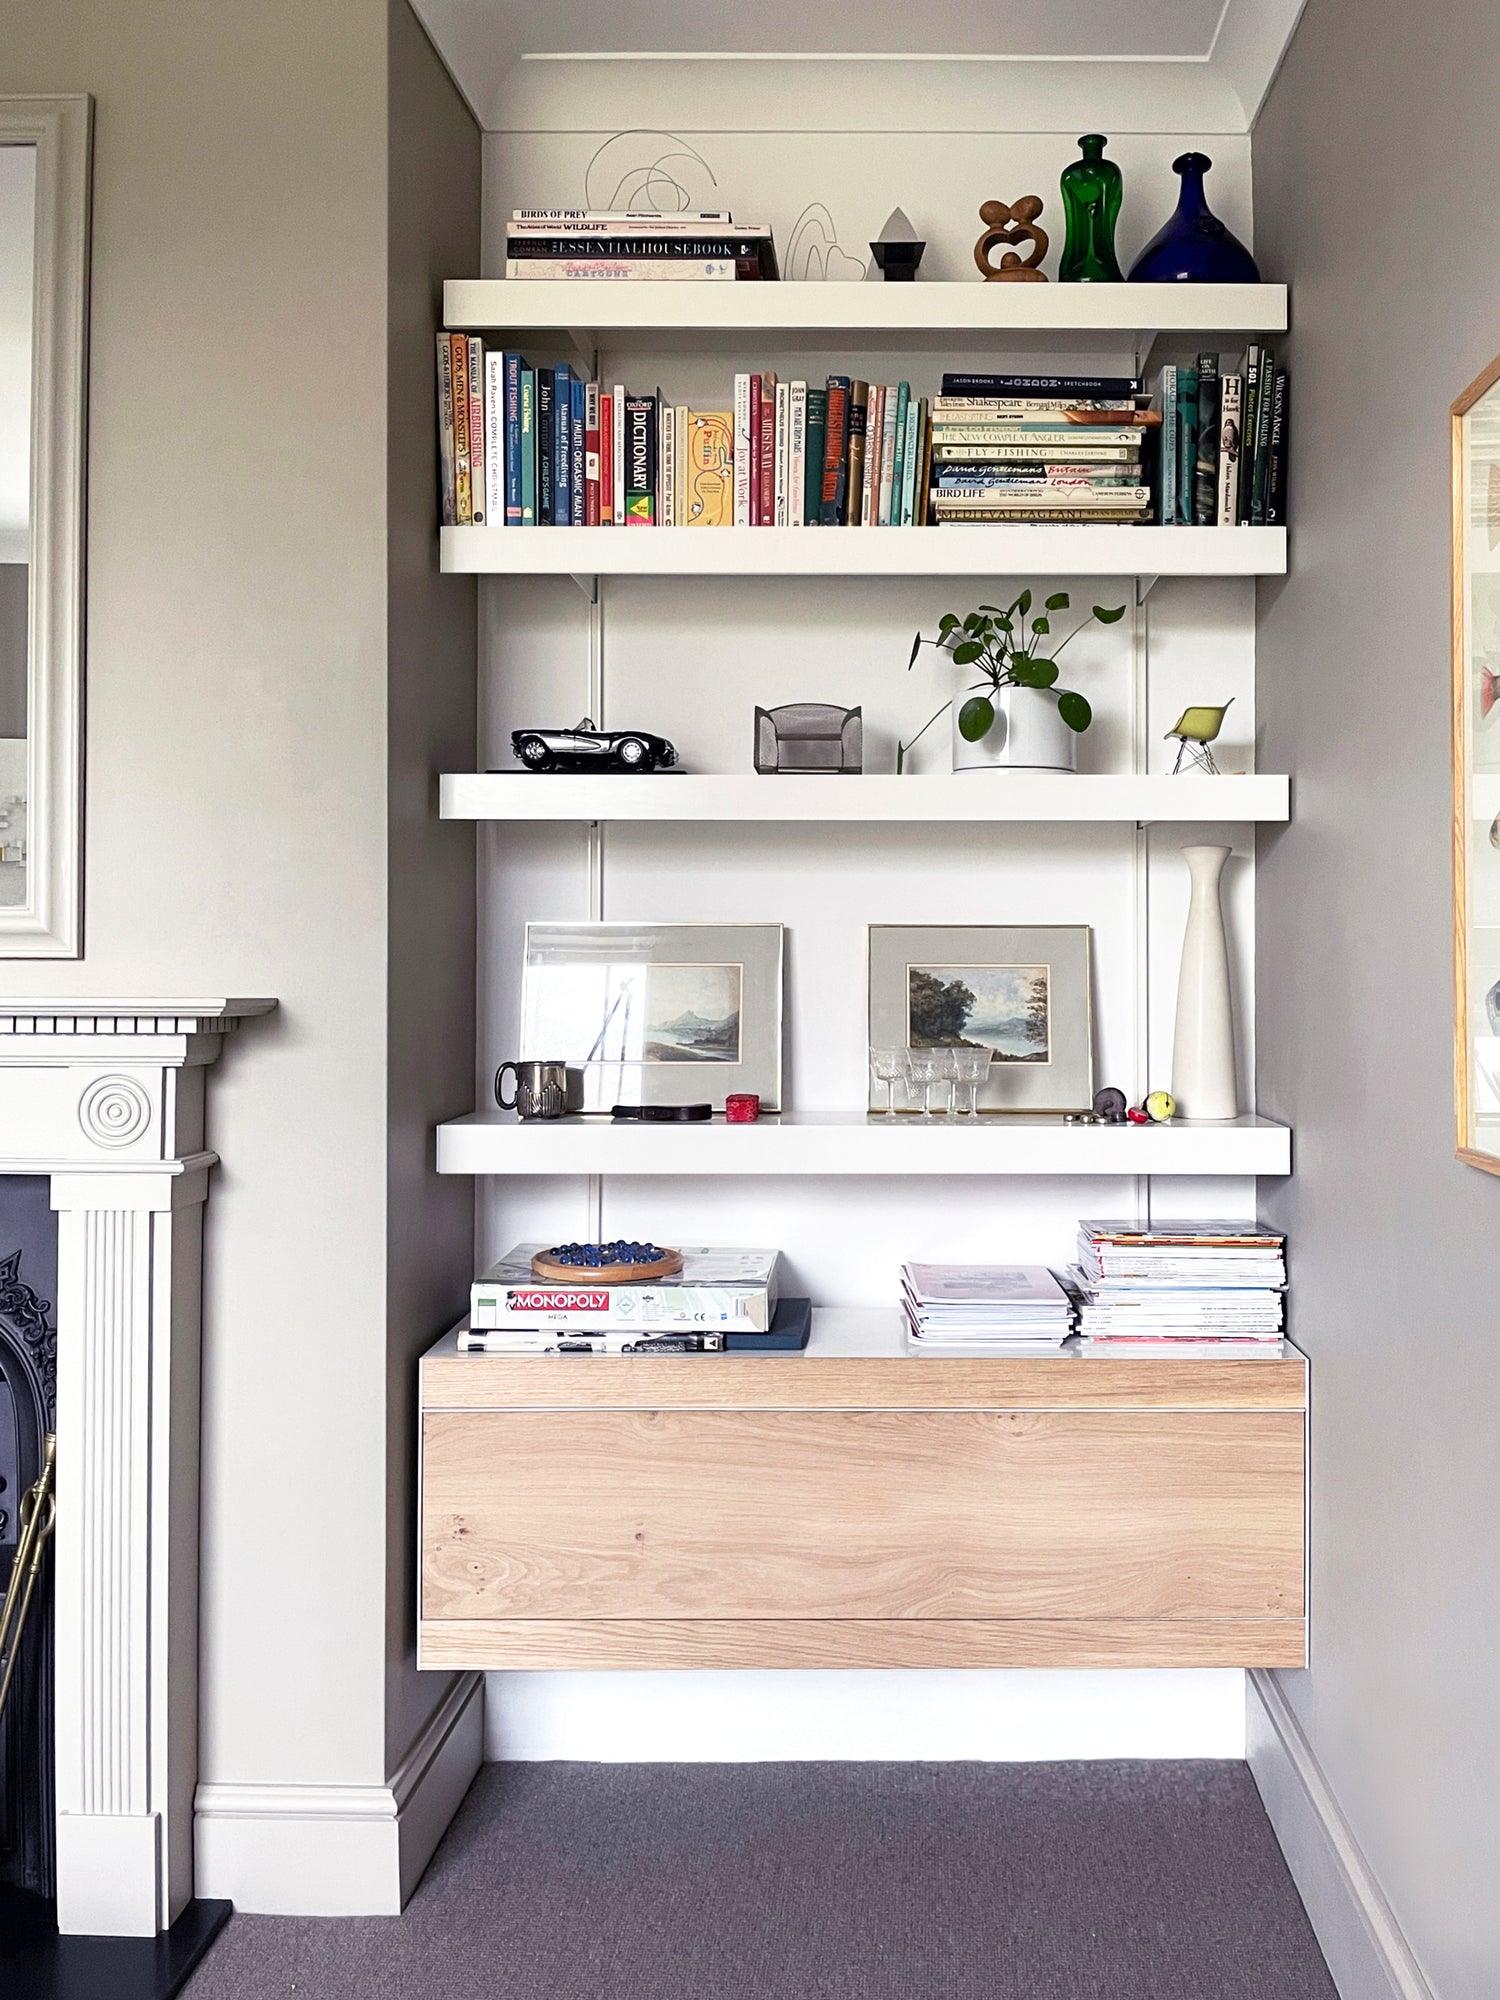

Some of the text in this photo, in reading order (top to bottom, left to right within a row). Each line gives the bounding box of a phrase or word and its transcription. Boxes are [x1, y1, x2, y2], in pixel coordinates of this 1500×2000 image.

[520, 210, 588, 219] BIRDS OF PREY
[470, 356, 478, 383] MANUAL
[509, 359, 518, 386] TROUT
[1248, 367, 1257, 385] 501
[1263, 365, 1273, 396] PASSION
[456, 375, 465, 396] MEN
[1224, 378, 1240, 395] H
[509, 386, 518, 422] FISHING
[521, 383, 532, 434] Coarse Fishing
[540, 384, 551, 412] John
[588, 393, 596, 426] WHY WE BUY
[966, 397, 1023, 410] Shakespeare
[1247, 389, 1255, 412] Pilates
[1262, 397, 1271, 413] FOR
[1271, 375, 1285, 446] WILSON'S ANGLE
[471, 396, 483, 468] AIRBRUSHING
[490, 360, 498, 513] Sarah Raven's COMPLETE CHRISTMAS
[941, 432, 958, 441] THE
[959, 432, 982, 441] NEW
[1029, 432, 1066, 442] ANGLER
[1246, 413, 1254, 447] Exercises
[1259, 414, 1269, 447] ANGLING
[558, 403, 569, 488] Manual of Freediving
[633, 412, 647, 490] DICTIONARY
[703, 430, 713, 465] Puffin
[736, 447, 748, 464] Joy
[793, 440, 803, 453] MARS
[822, 390, 845, 503] UNDERSTANDING MEDIA
[967, 448, 989, 457] FLY
[997, 448, 1047, 457] FISHING
[738, 465, 747, 476] at
[761, 452, 773, 469] WAY
[942, 465, 977, 475] David
[1047, 465, 1093, 475] Britain
[863, 457, 874, 489] FISHING
[1050, 478, 1094, 486] London
[738, 478, 748, 508] Work
[936, 489, 986, 498] BIRD LIFE
[573, 495, 583, 517] MAN
[940, 510, 1015, 519] MEDIEVAL
[1019, 510, 1083, 518] PAGEANT
[517, 1293, 607, 1309] MONOPOLY
